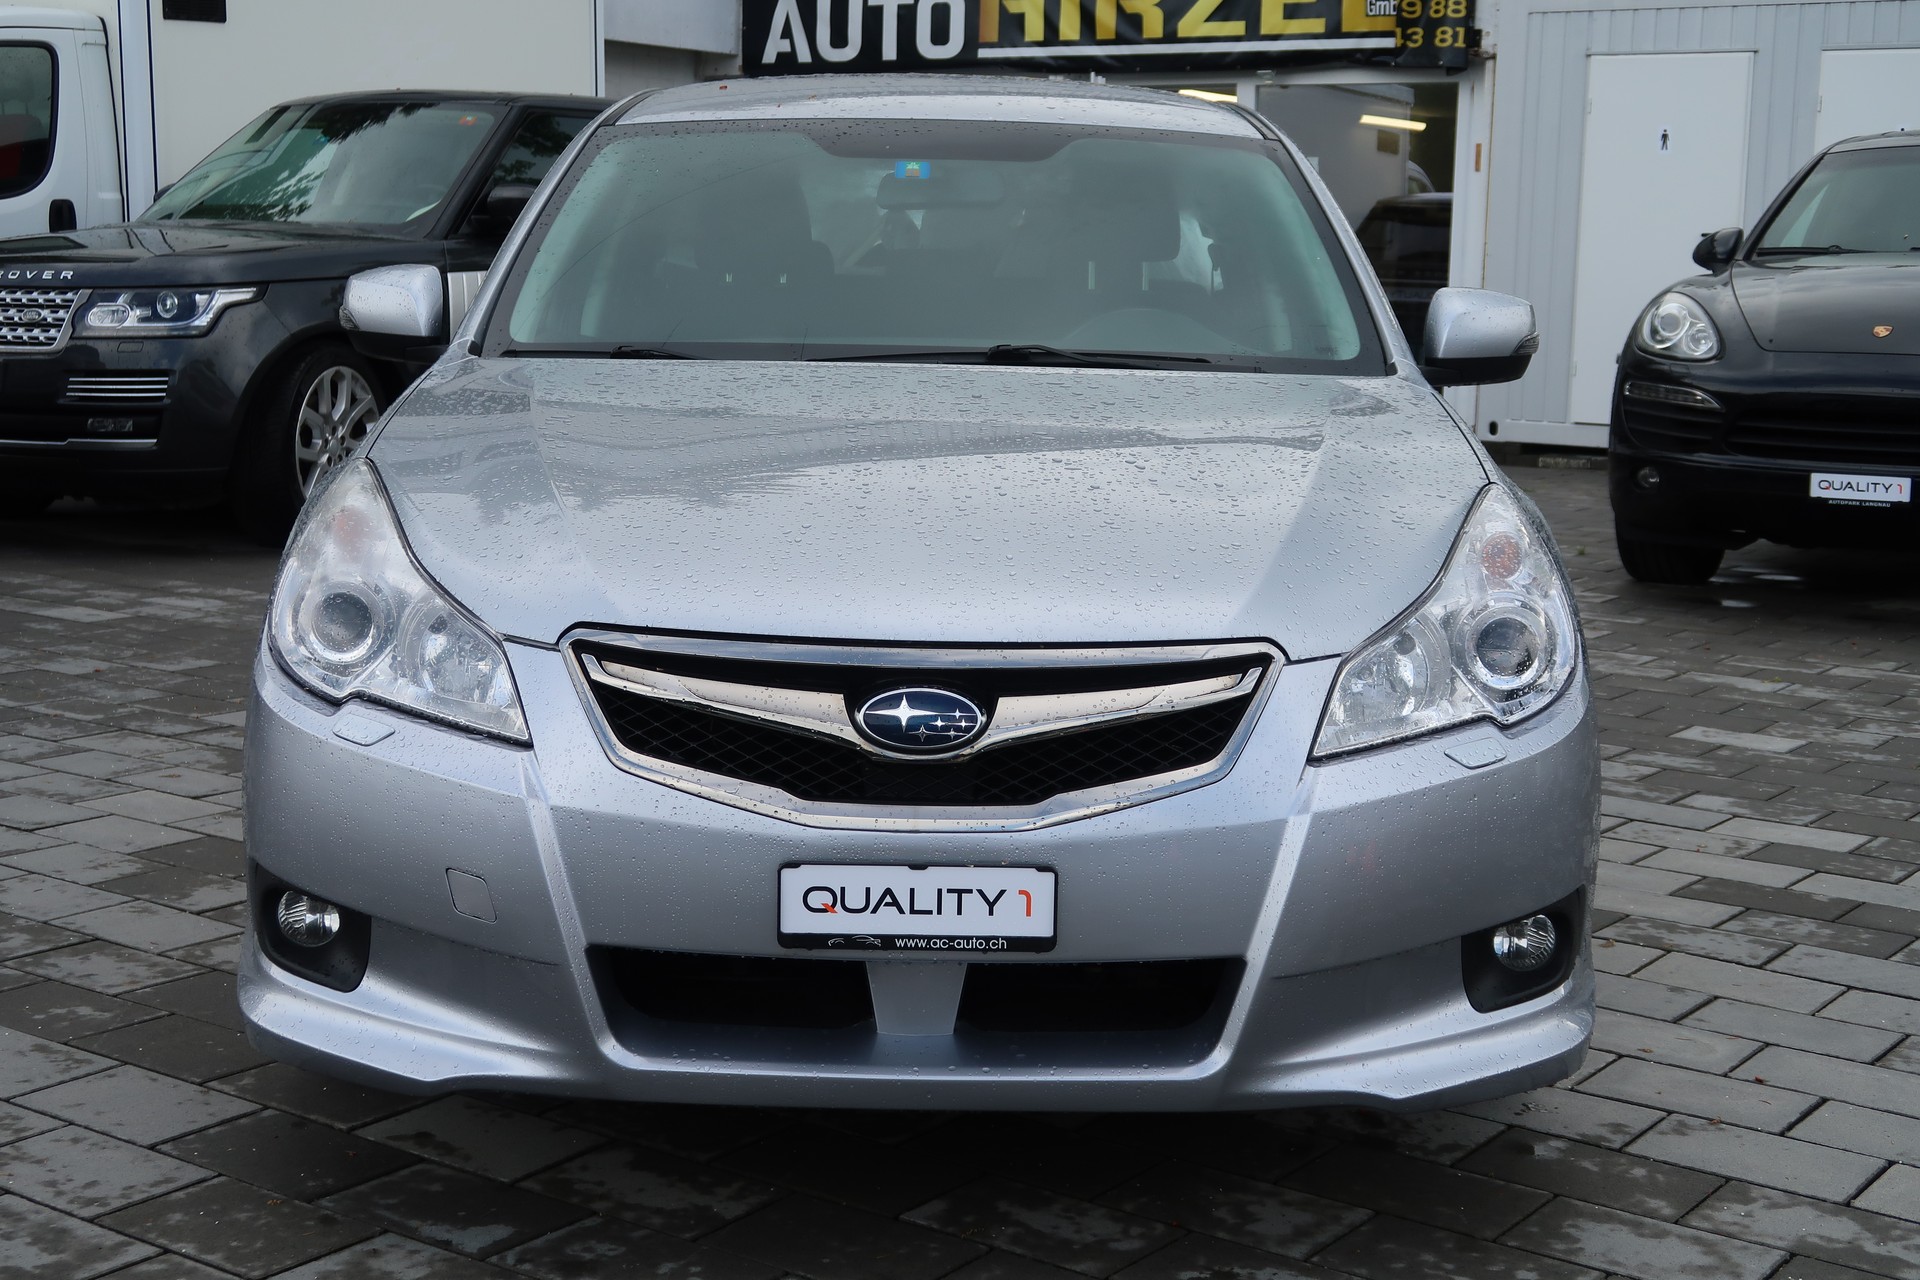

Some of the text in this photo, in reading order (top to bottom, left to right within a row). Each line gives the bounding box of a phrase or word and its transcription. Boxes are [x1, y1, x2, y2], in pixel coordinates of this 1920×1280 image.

[761, 0, 965, 64] AUTO
[1434, 26, 1467, 48] 81
[1818, 479, 1903, 494] QUALITY 1
[802, 886, 1032, 917] QUALITY 1
[895, 936, 1007, 949] www.ac-auto.ch
